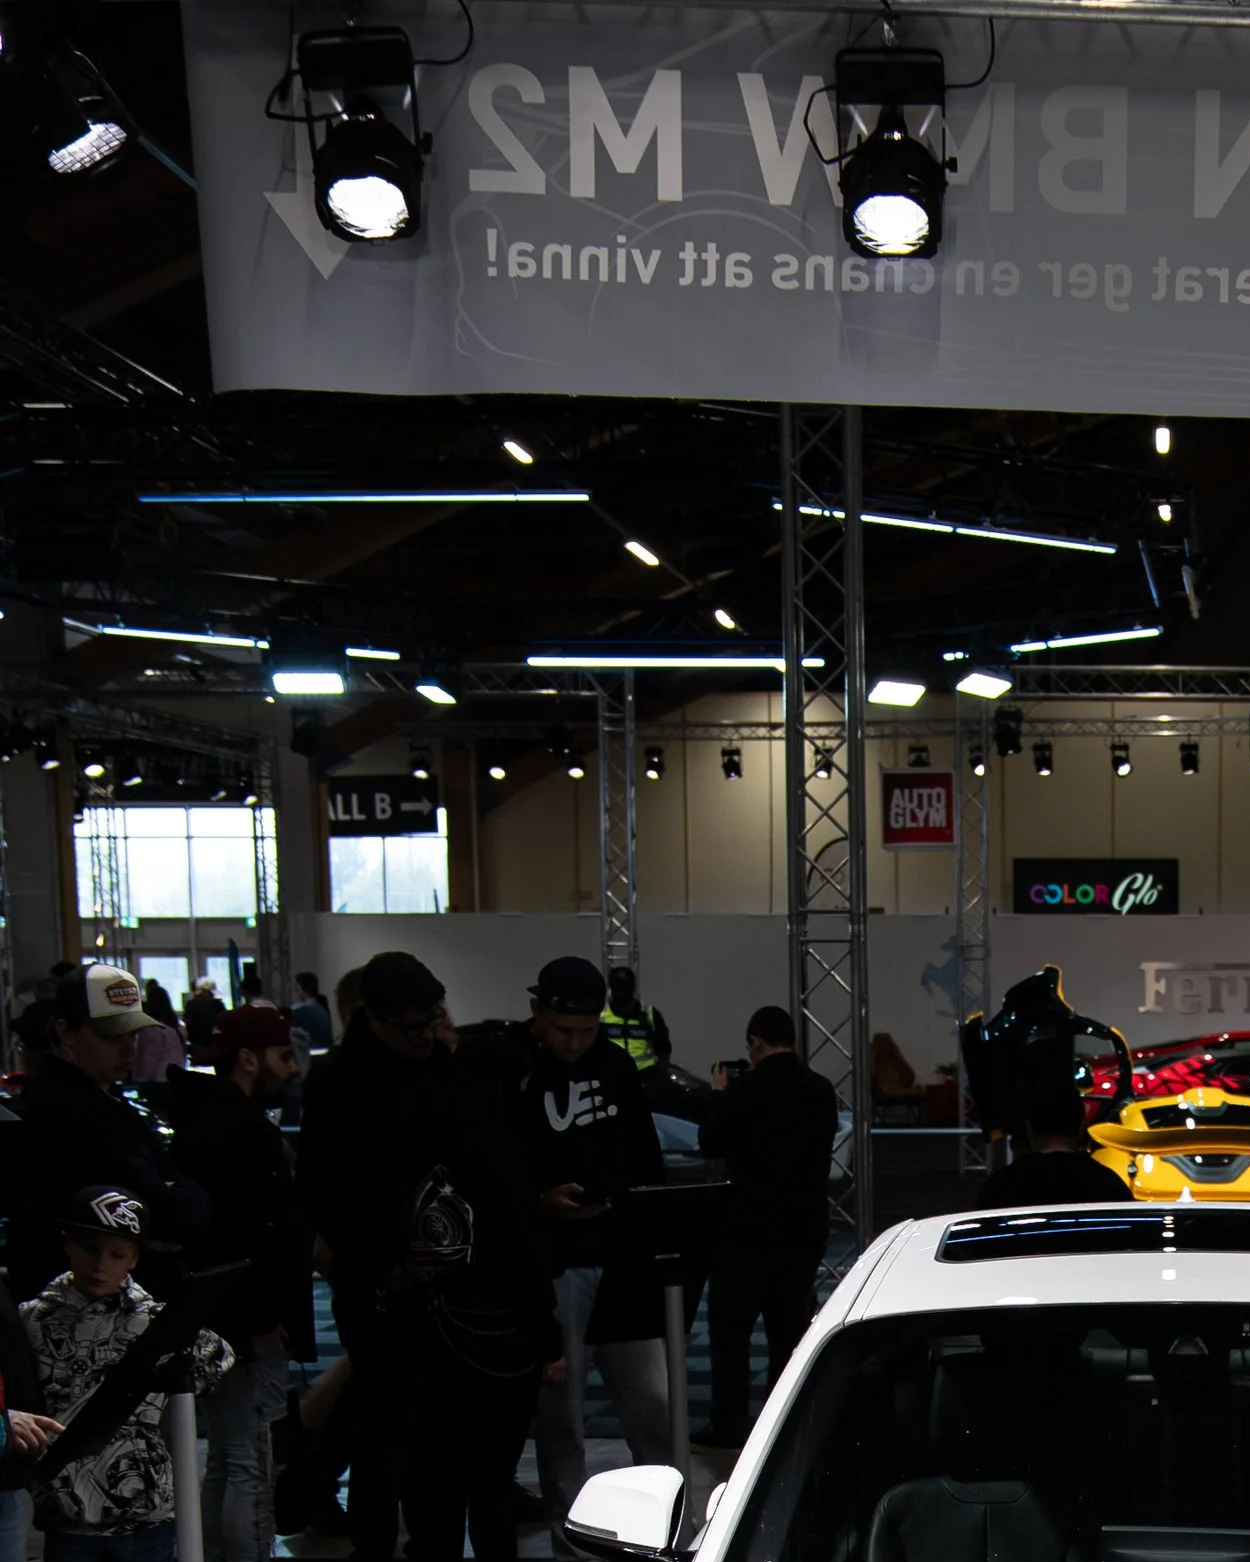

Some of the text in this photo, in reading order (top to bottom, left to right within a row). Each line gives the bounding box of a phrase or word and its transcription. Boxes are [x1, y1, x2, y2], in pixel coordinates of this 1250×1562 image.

[374, 792, 393, 820] B
[891, 787, 946, 808] AUTO
[890, 807, 947, 829] GLYM
[1029, 872, 1160, 916] COLOR Glo
